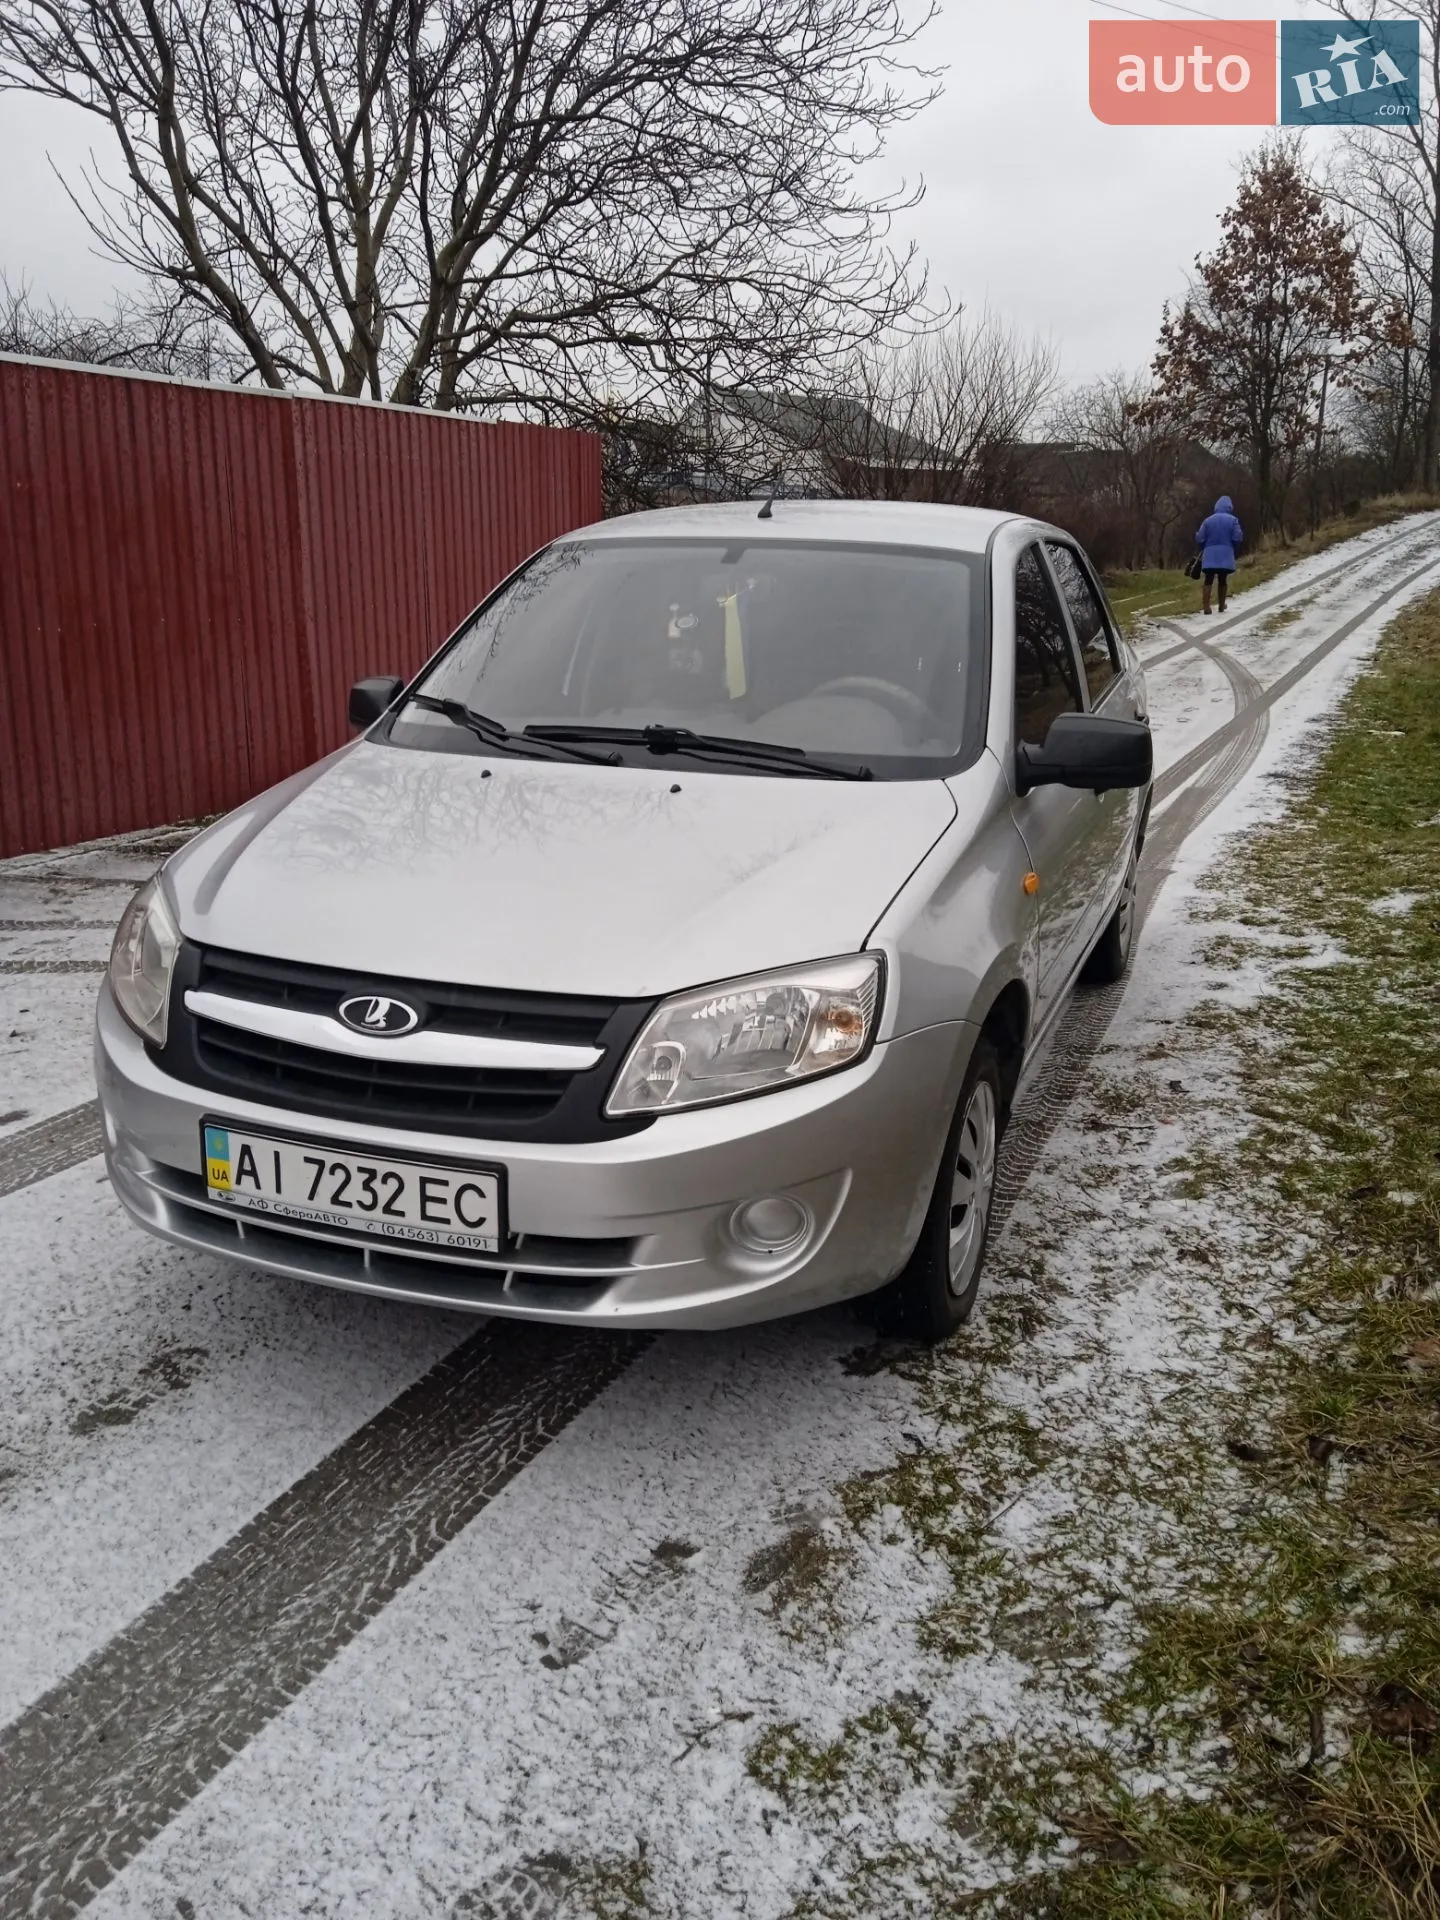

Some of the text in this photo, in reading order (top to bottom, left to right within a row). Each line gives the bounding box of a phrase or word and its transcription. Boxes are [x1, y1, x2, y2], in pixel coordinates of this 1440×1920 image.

[212, 1166, 229, 1184] UA
[235, 1143, 488, 1229] AI 7232 EC
[381, 1222, 440, 1243] (04563)
[447, 1234, 489, 1250] 60191
